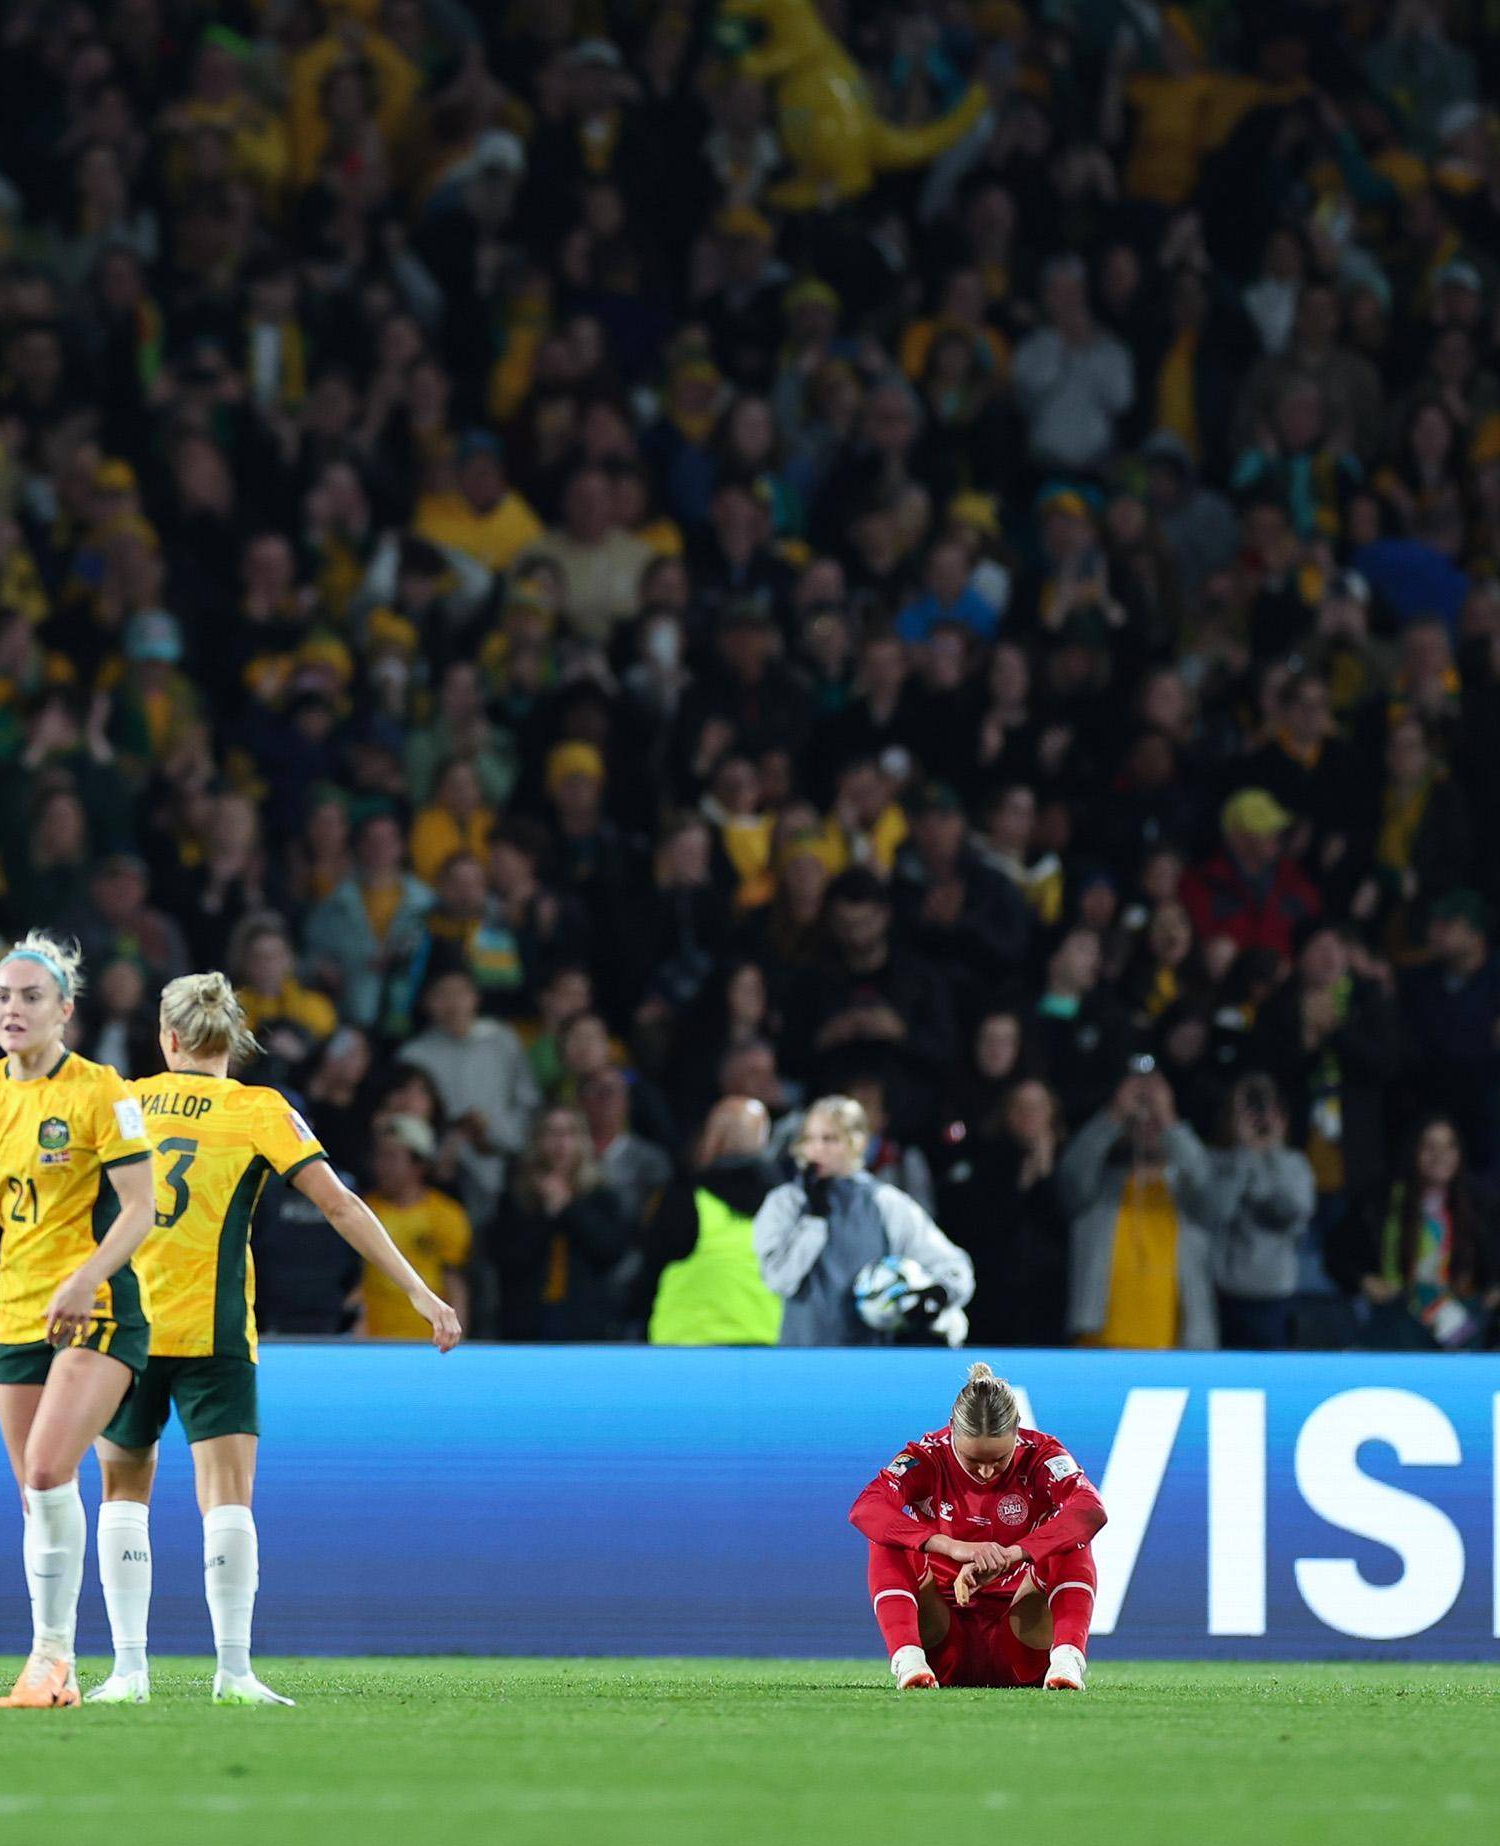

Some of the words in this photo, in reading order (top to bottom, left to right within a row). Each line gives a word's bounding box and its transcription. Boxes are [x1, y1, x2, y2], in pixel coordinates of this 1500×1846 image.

[141, 1093, 212, 1119] YALLOP
[8, 1177, 37, 1224] 21
[155, 1137, 198, 1228] 3
[1003, 1503, 1022, 1515] DBU
[1008, 1386, 1500, 1640] VIS
[122, 1550, 148, 1562] AUS
